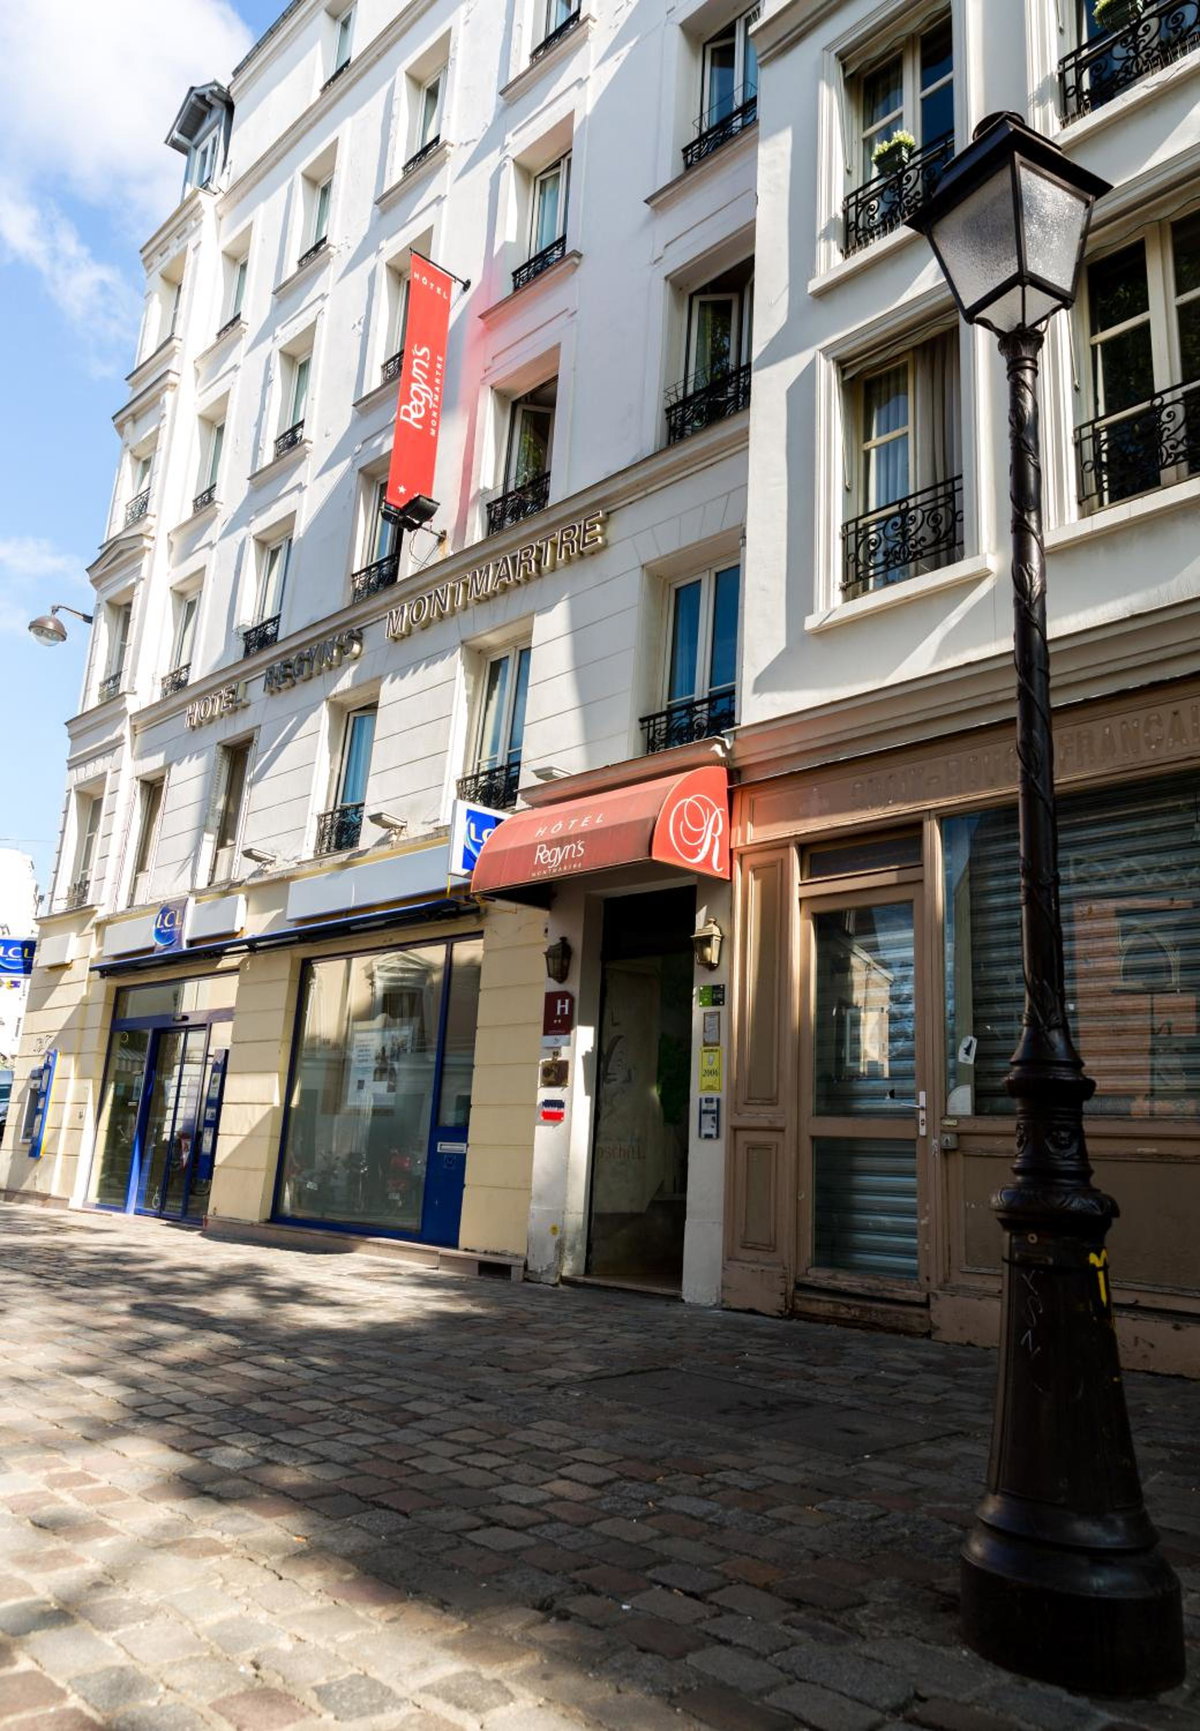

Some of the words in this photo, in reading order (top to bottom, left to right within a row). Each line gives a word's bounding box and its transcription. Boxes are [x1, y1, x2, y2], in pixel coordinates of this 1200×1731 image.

[430, 355, 444, 437] MONTMARTRE
[385, 511, 609, 640] MONTMARTRE
[156, 910, 182, 929] LCL
[555, 998, 570, 1016] H
